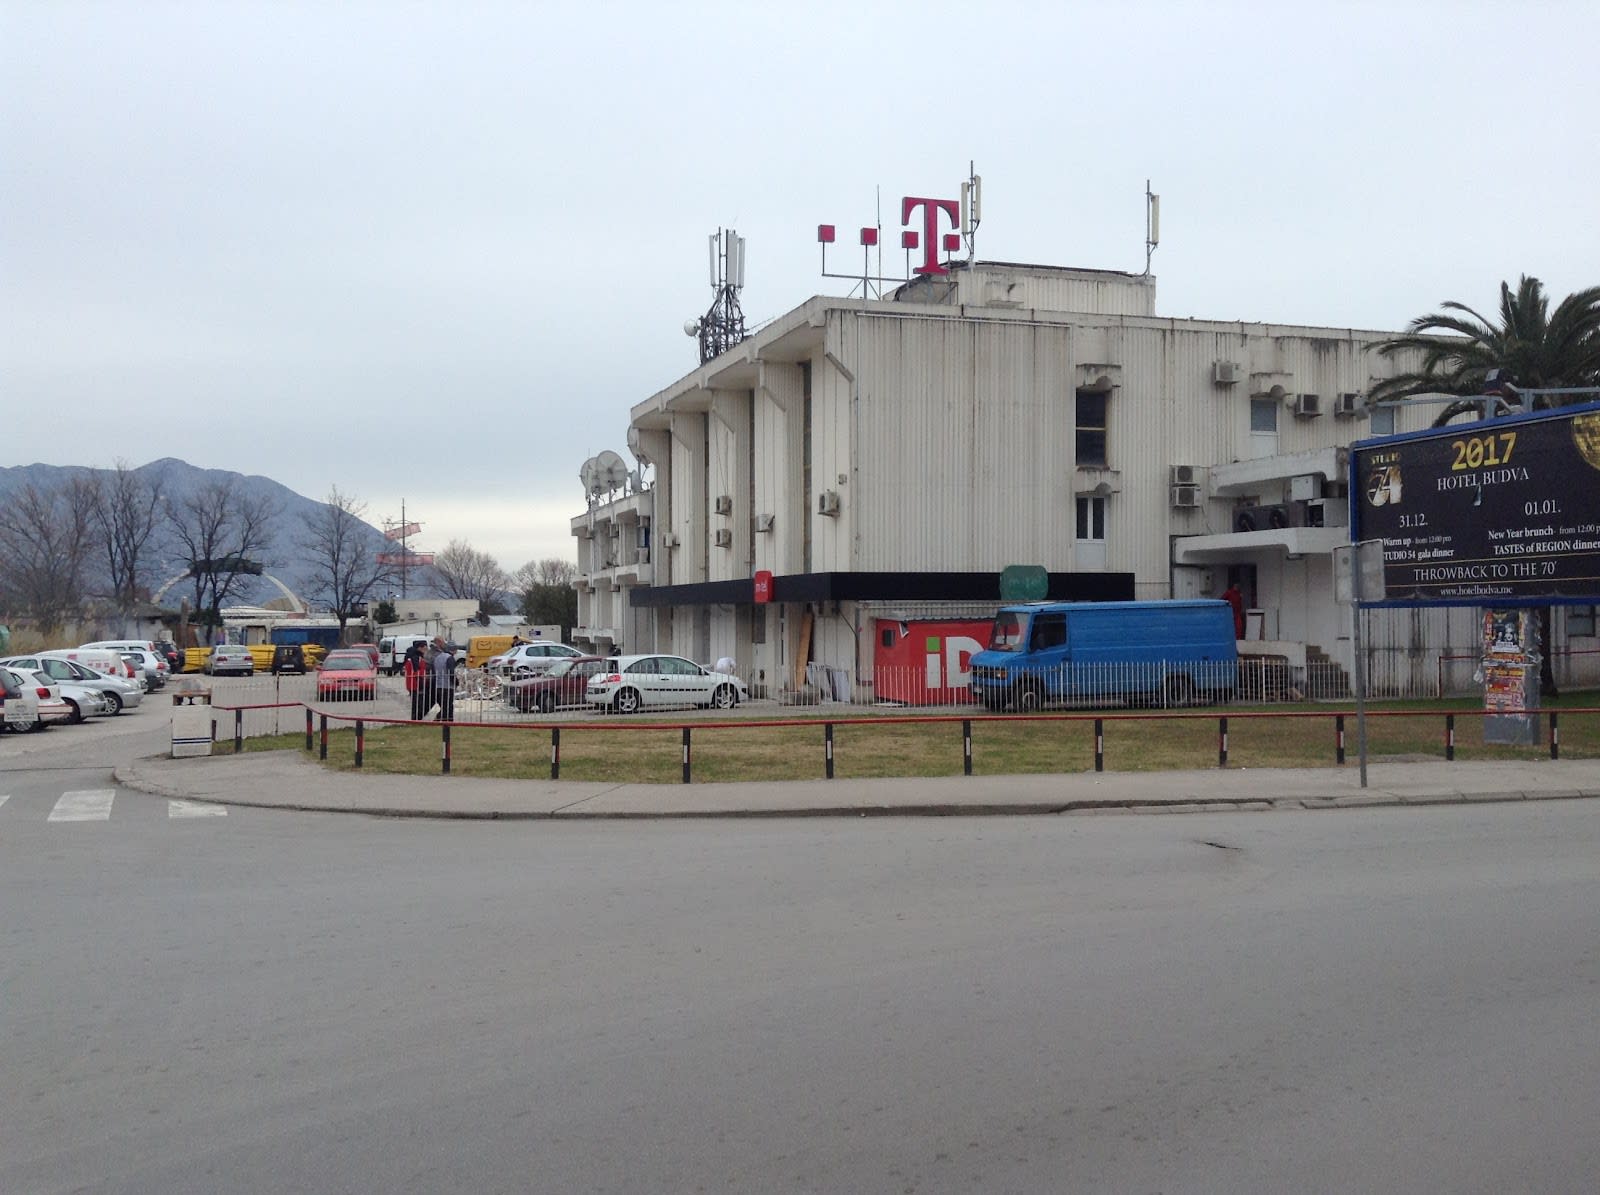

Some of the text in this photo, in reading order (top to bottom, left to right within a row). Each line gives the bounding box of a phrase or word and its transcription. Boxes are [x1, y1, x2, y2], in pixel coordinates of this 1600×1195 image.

[902, 196, 960, 276] T
[1451, 431, 1517, 471] 2017
[1437, 466, 1530, 491] HOTEL BUDVA
[1524, 499, 1562, 516] 01.01.
[1399, 513, 1429, 528] 31.12.
[1488, 530, 1505, 540] New
[1506, 529, 1523, 539] Year
[1524, 525, 1554, 537] brunch
[1559, 526, 1576, 535] from
[1577, 524, 1595, 533] 12:00
[1383, 537, 1402, 547] Warm
[1402, 537, 1412, 547] up
[1494, 539, 1600, 555] TASTES of REGION dinner
[1384, 551, 1407, 560] TUDIO
[1417, 549, 1431, 561] gala
[1431, 547, 1455, 558] dinner
[1413, 566, 1488, 581] THROWBACK
[1490, 564, 1508, 577] TO
[1511, 563, 1537, 576] THE
[1440, 585, 1513, 596] www.hotelbudva.me
